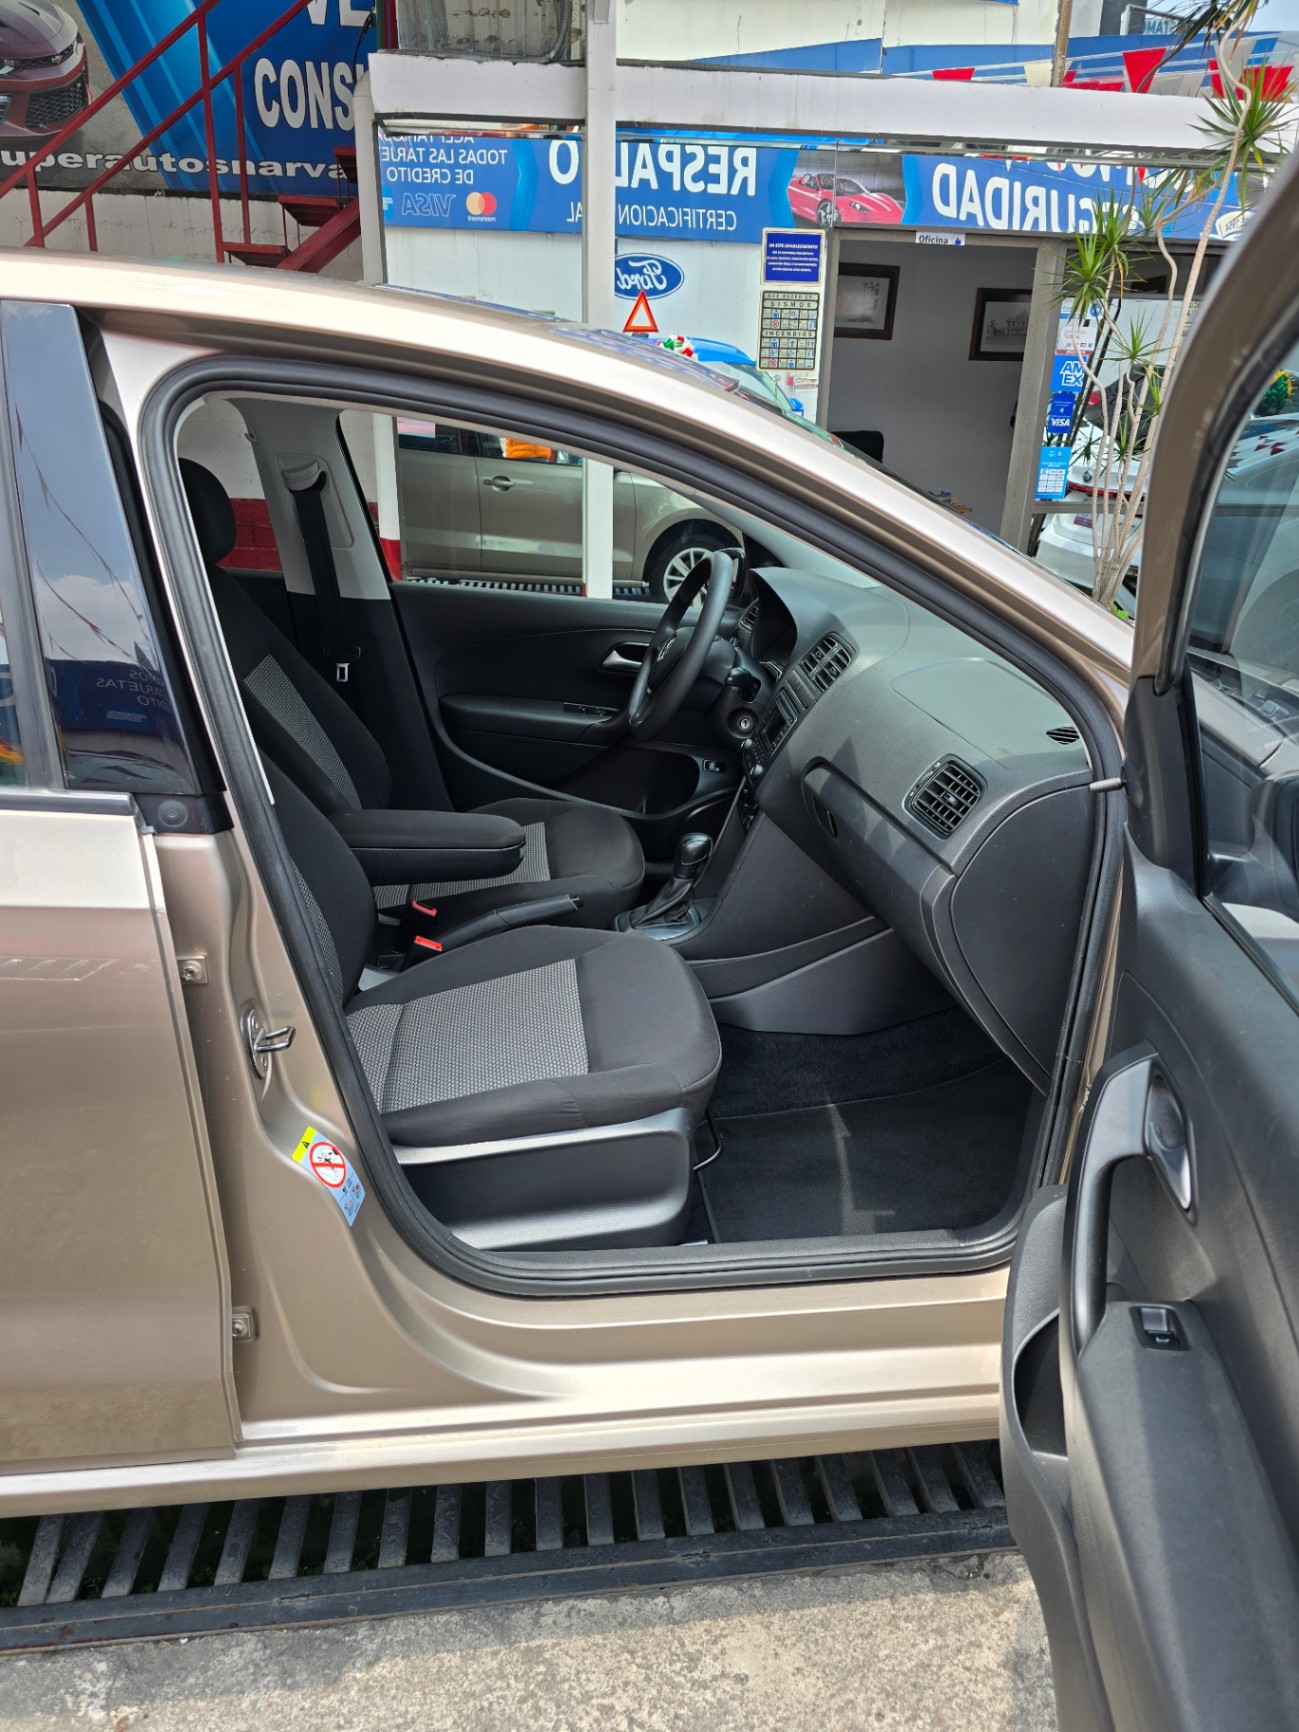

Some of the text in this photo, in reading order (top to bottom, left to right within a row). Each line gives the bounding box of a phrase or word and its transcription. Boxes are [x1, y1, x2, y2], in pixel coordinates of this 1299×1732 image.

[255, 58, 365, 132] CONS
[918, 235, 950, 245] Oficina
[770, 300, 812, 308] SISMOS
[1061, 372, 1084, 387] EX
[1050, 417, 1071, 427] VISA
